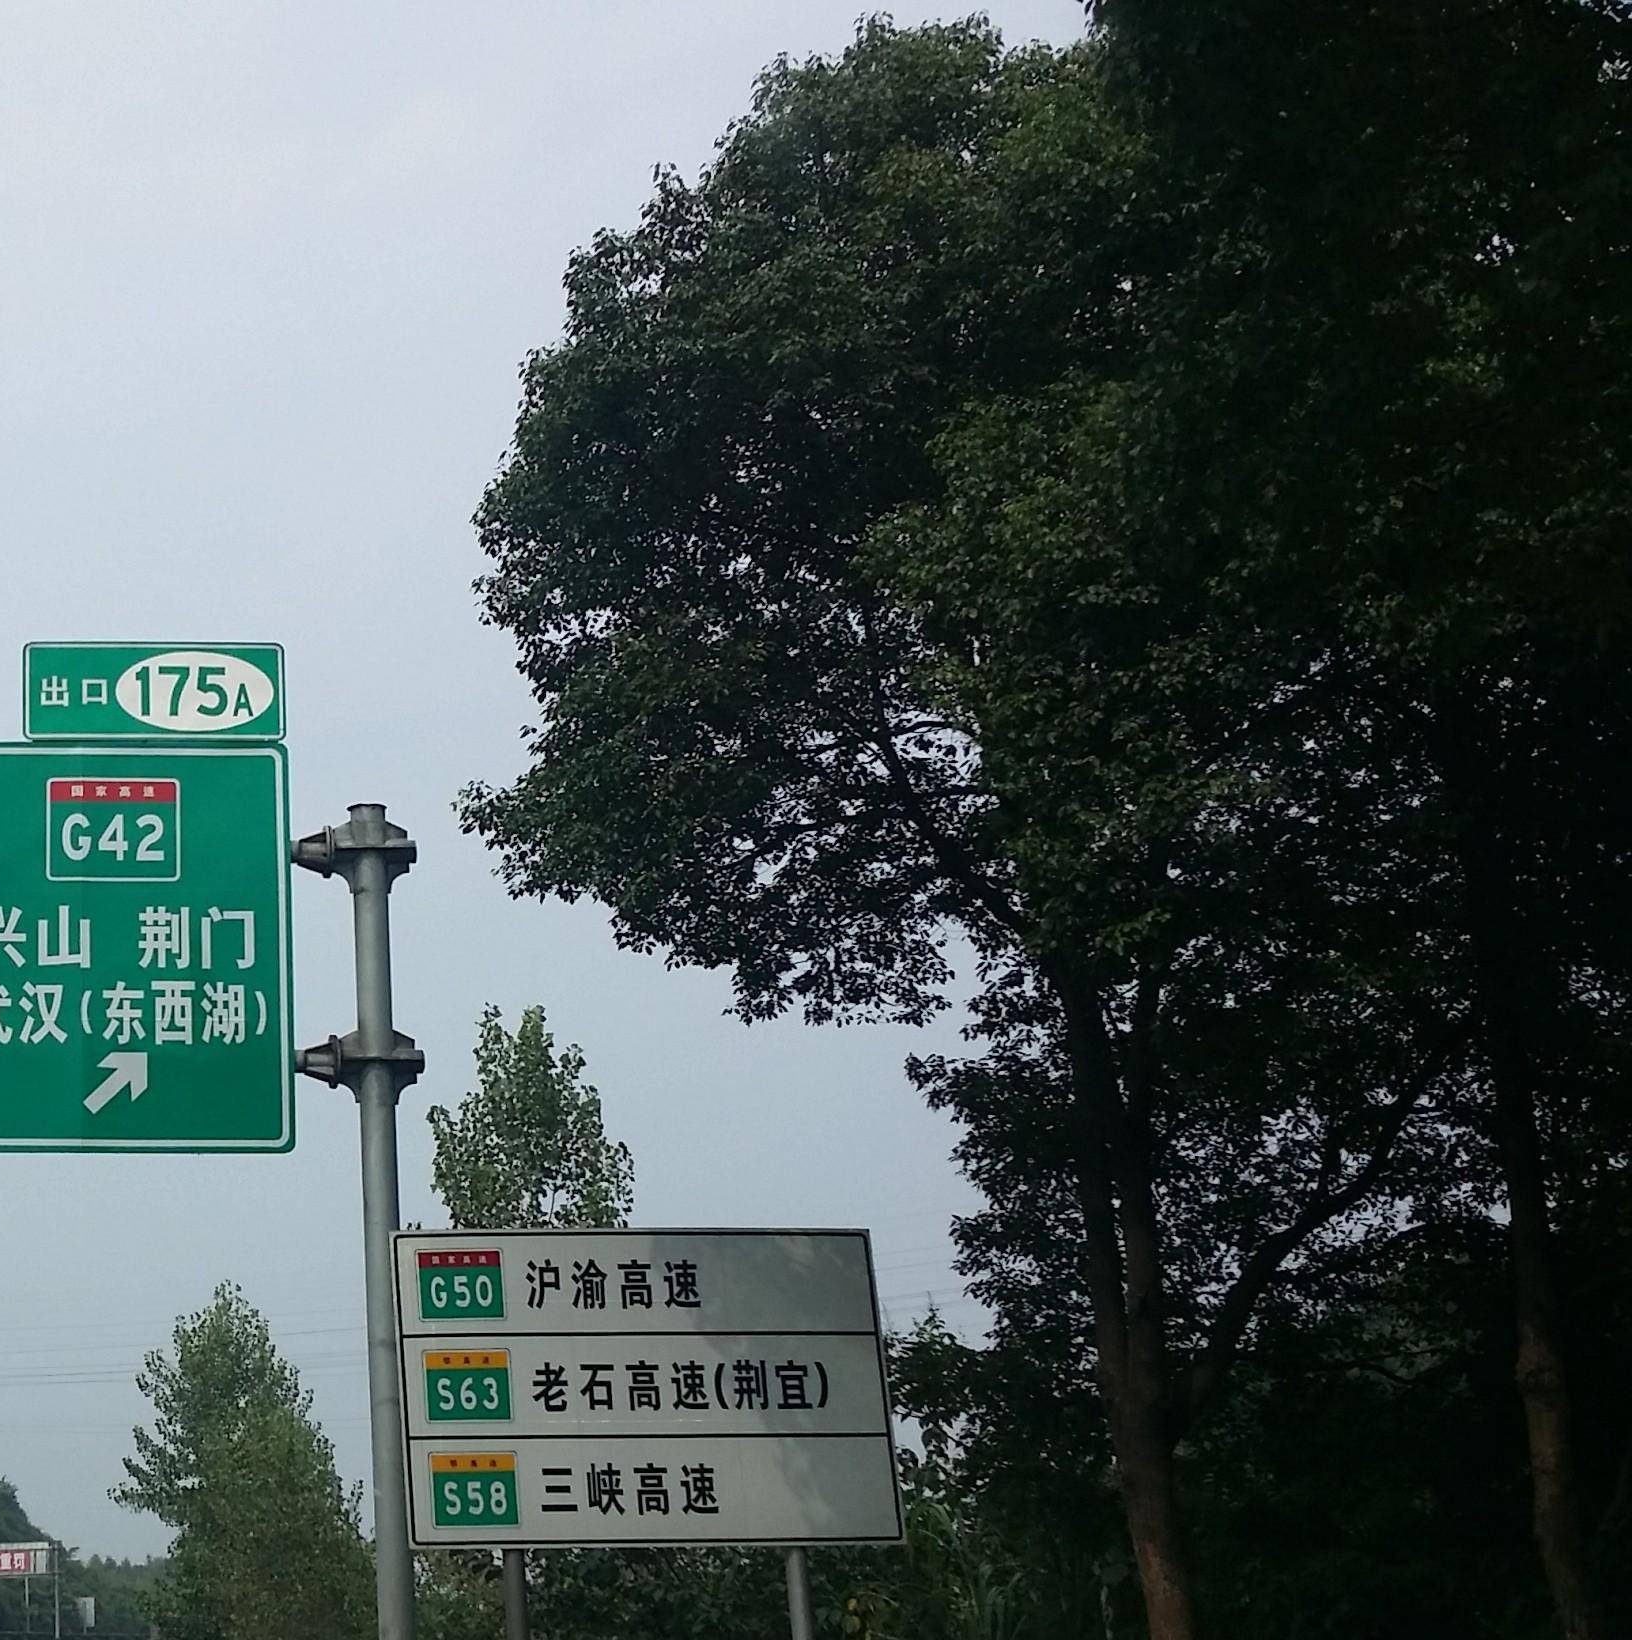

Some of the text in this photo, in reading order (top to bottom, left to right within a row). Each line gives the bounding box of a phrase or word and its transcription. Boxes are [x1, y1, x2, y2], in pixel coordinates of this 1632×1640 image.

[40, 666, 254, 718] 出口 175A
[62, 813, 165, 861] G42
[139, 906, 255, 969] 荆门
[431, 1275, 492, 1308] G50
[526, 1259, 701, 1310] 沪渝高速
[438, 1377, 498, 1410] S63
[533, 1359, 829, 1412] 老石高速(荆宜)
[444, 1481, 507, 1515] S58
[541, 1463, 720, 1516] 三峡高速
